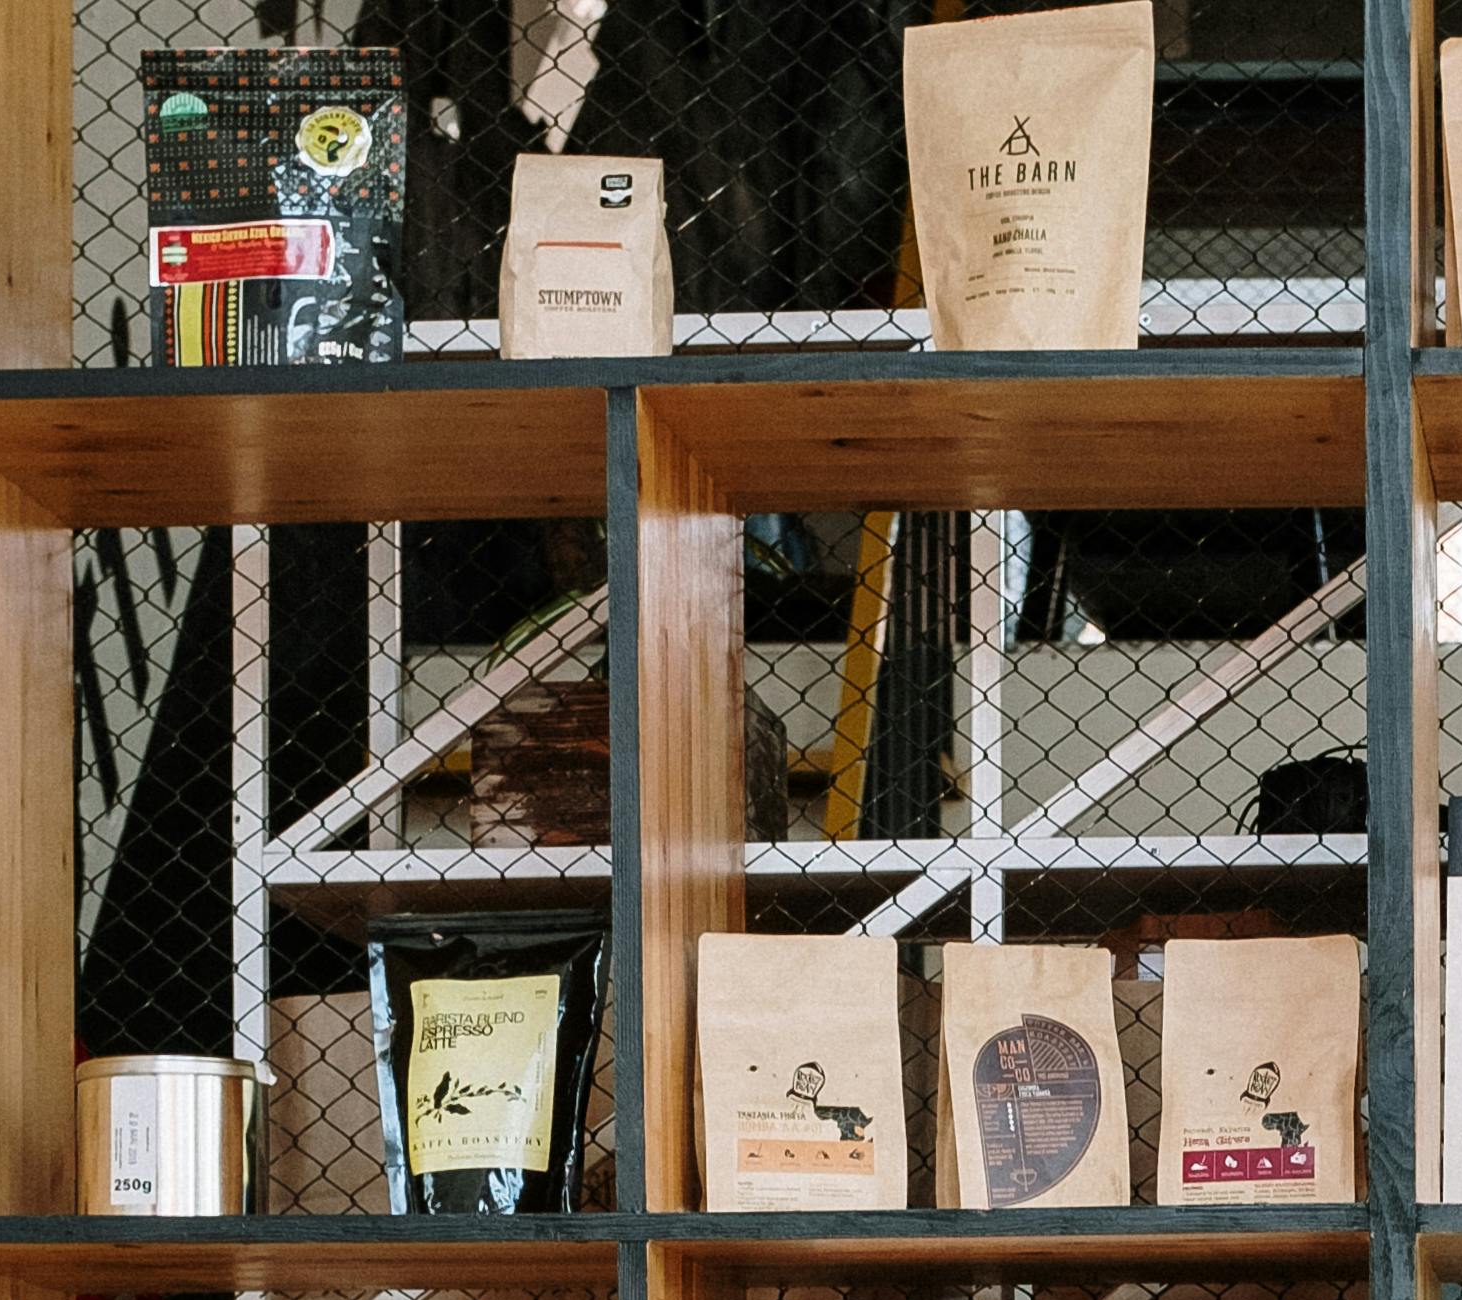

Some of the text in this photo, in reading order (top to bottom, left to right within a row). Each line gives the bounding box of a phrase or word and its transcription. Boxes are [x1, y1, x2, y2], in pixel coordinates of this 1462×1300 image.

[968, 161, 1076, 190] THE BARN
[538, 290, 622, 307] STUMPTOWN
[998, 1040, 1025, 1053] MAN
[114, 1178, 151, 1194] 250g
